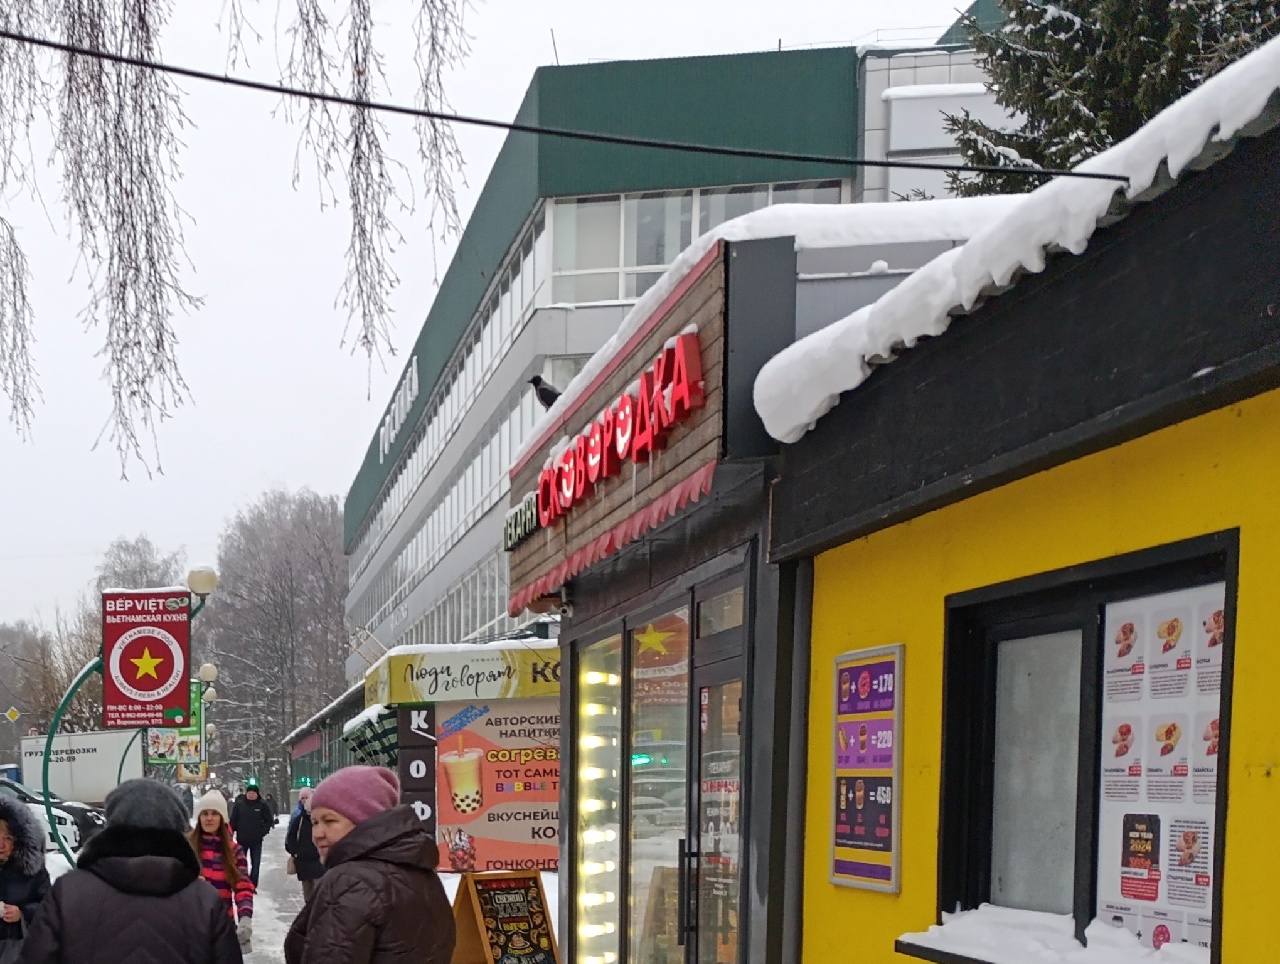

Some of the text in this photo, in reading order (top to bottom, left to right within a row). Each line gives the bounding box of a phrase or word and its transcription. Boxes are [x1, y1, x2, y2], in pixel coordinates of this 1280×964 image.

[538, 334, 696, 528] СКОВОРОДКА
[106, 613, 188, 623] ВЬЕТНАМСКАЯ КУХНЯ
[118, 628, 174, 650] VIETNAMESE FOOD
[404, 664, 452, 695] Люди
[442, 664, 515, 697] говорят
[485, 715, 560, 727] АВТОРСКИЕ
[500, 728, 560, 738] НАПИТКИ
[486, 748, 560, 765] согрев
[495, 769, 520, 778] ТОТ
[496, 781, 547, 792] BUBBLE
[531, 826, 559, 839] КО
